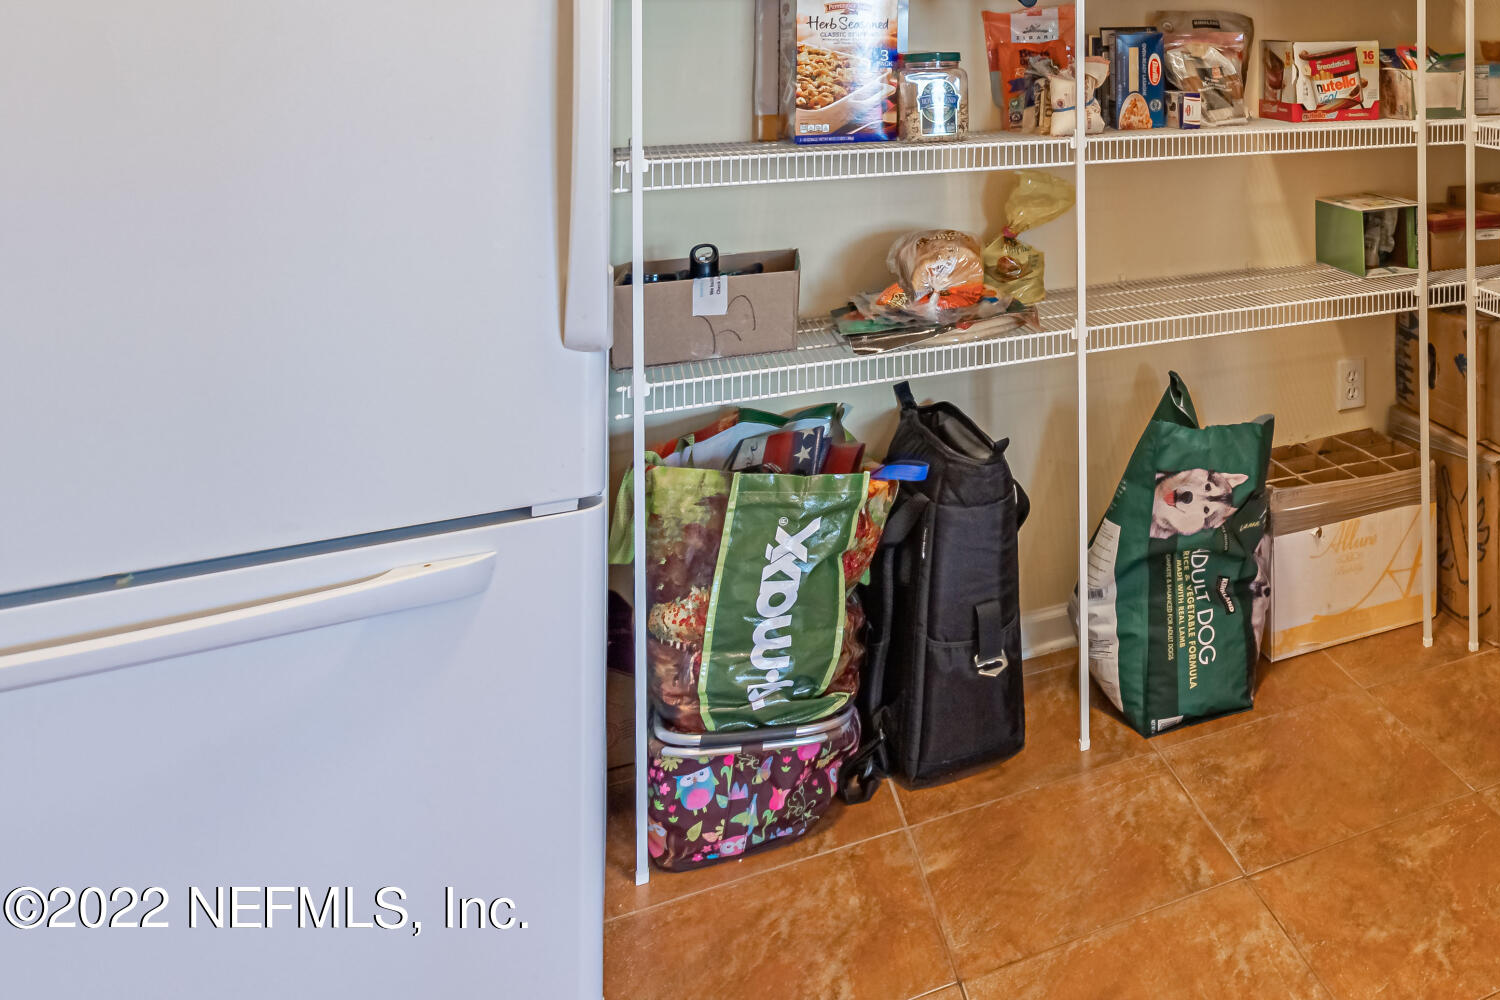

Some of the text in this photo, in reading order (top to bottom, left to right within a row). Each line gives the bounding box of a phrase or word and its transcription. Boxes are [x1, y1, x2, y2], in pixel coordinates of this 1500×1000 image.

[806, 16, 837, 30] Herb
[880, 49, 889, 61] 3
[1316, 59, 1350, 70] Breadsticks
[1362, 51, 1375, 60] 16
[1151, 59, 1159, 84] Barilla
[1316, 76, 1357, 93] nutella
[1176, 559, 1184, 582] MADE
[1219, 577, 1235, 613] KIRKLAND
[1185, 584, 1196, 638] VEGETABLE
[1178, 626, 1186, 648] LAMB
[1197, 607, 1217, 665] DOG
[1188, 640, 1198, 690] FORMULA
